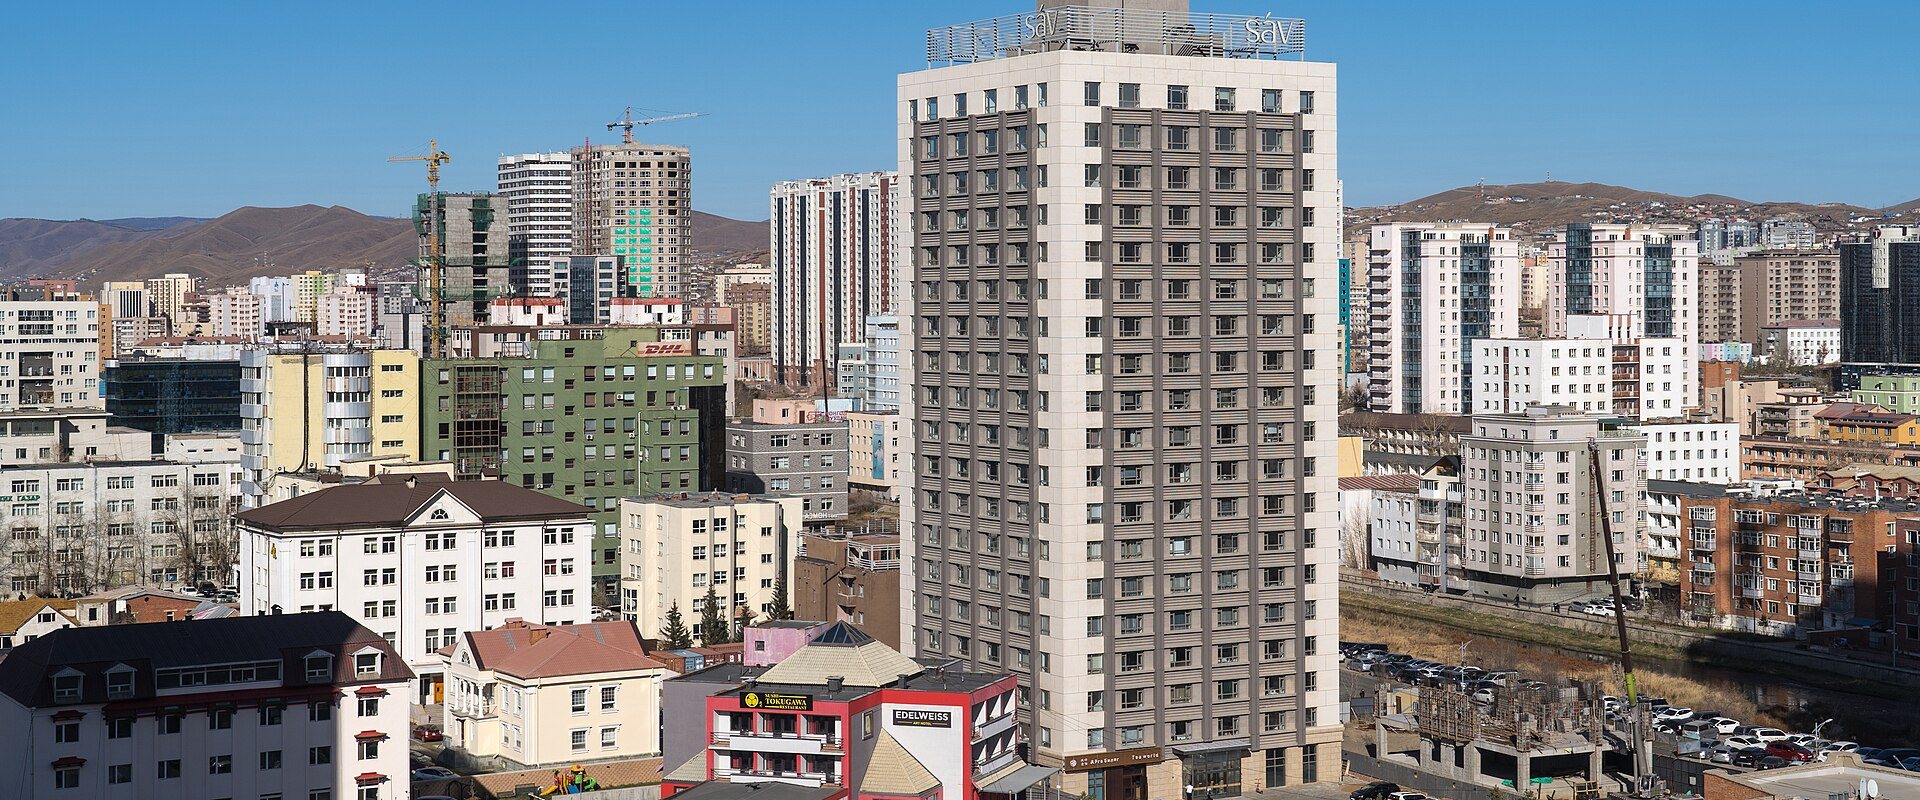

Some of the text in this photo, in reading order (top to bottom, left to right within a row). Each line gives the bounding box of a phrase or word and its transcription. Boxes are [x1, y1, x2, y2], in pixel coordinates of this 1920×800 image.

[645, 344, 685, 354] DHL
[764, 698, 807, 706] TOKUGAWA
[895, 711, 949, 721] EDELWEISS
